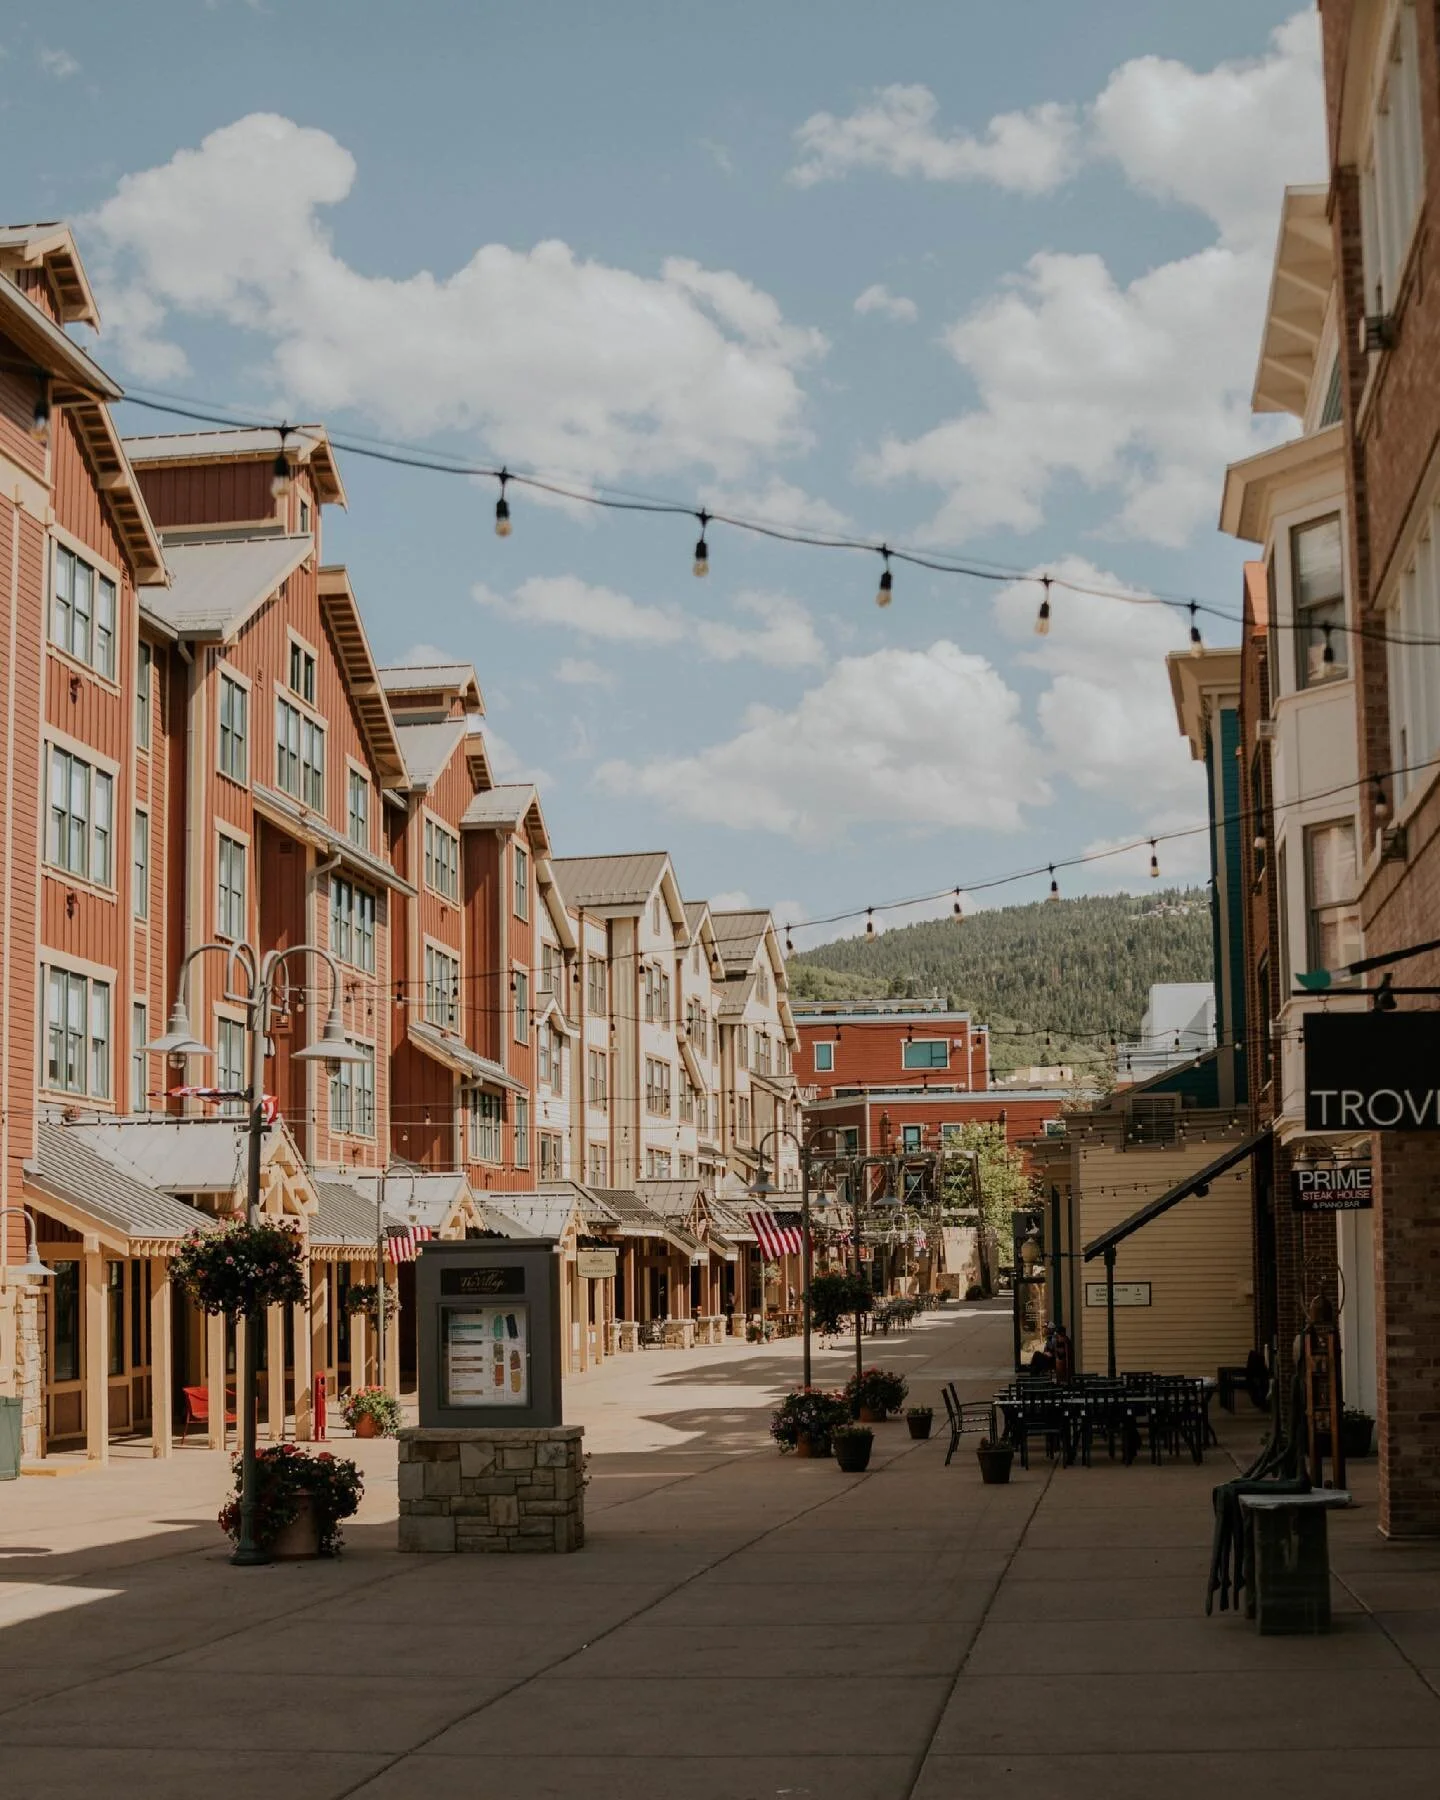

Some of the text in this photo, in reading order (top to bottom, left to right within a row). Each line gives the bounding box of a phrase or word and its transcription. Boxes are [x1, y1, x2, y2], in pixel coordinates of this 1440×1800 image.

[1310, 1089, 1440, 1126] TROV
[1299, 1169, 1372, 1191] PRIME
[1302, 1190, 1370, 1201] STEAK HOUSE
[1319, 1201, 1343, 1209] PIANO
[1344, 1200, 1360, 1208] BAR
